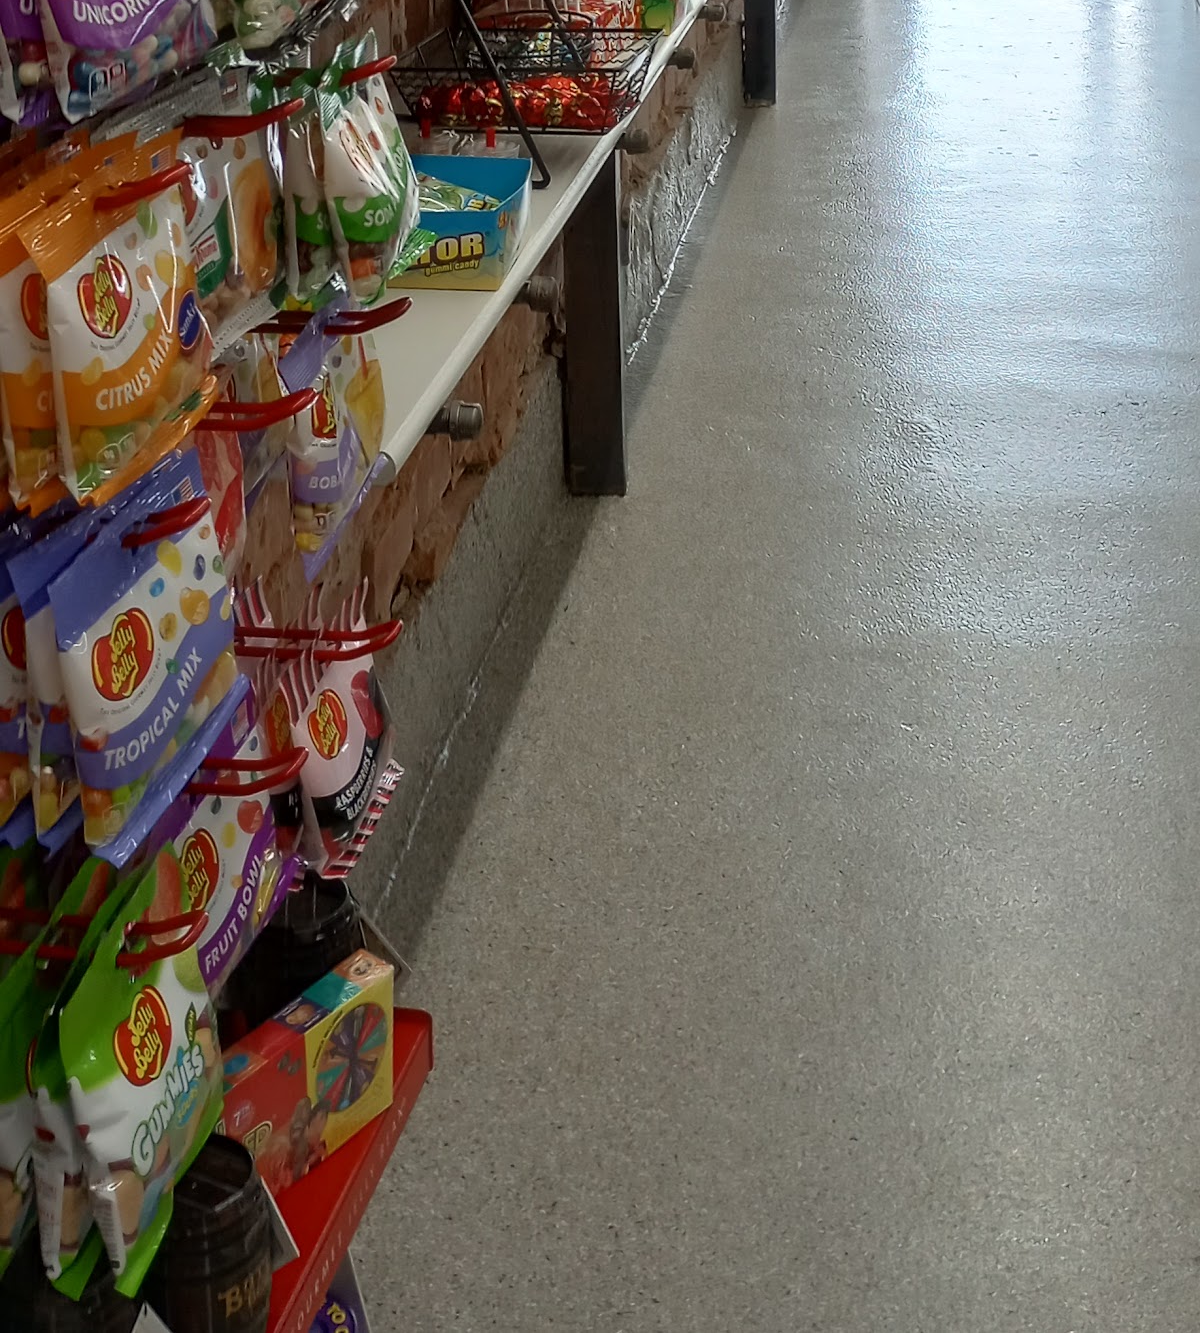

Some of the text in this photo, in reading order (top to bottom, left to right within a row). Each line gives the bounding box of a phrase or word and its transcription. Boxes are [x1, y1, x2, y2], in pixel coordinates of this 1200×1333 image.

[425, 259, 480, 276] gummi candy
[95, 295, 119, 336] Belly
[95, 367, 151, 411] CITRUS
[147, 329, 174, 375] MIX
[109, 614, 137, 663] Jelly
[111, 650, 139, 696] Belly
[104, 647, 203, 771] TROPICAL MIX
[205, 917, 239, 974] FRUIT
[237, 854, 262, 921] BOWL
[128, 992, 157, 1047] Jelly
[133, 1028, 164, 1079] Belly
